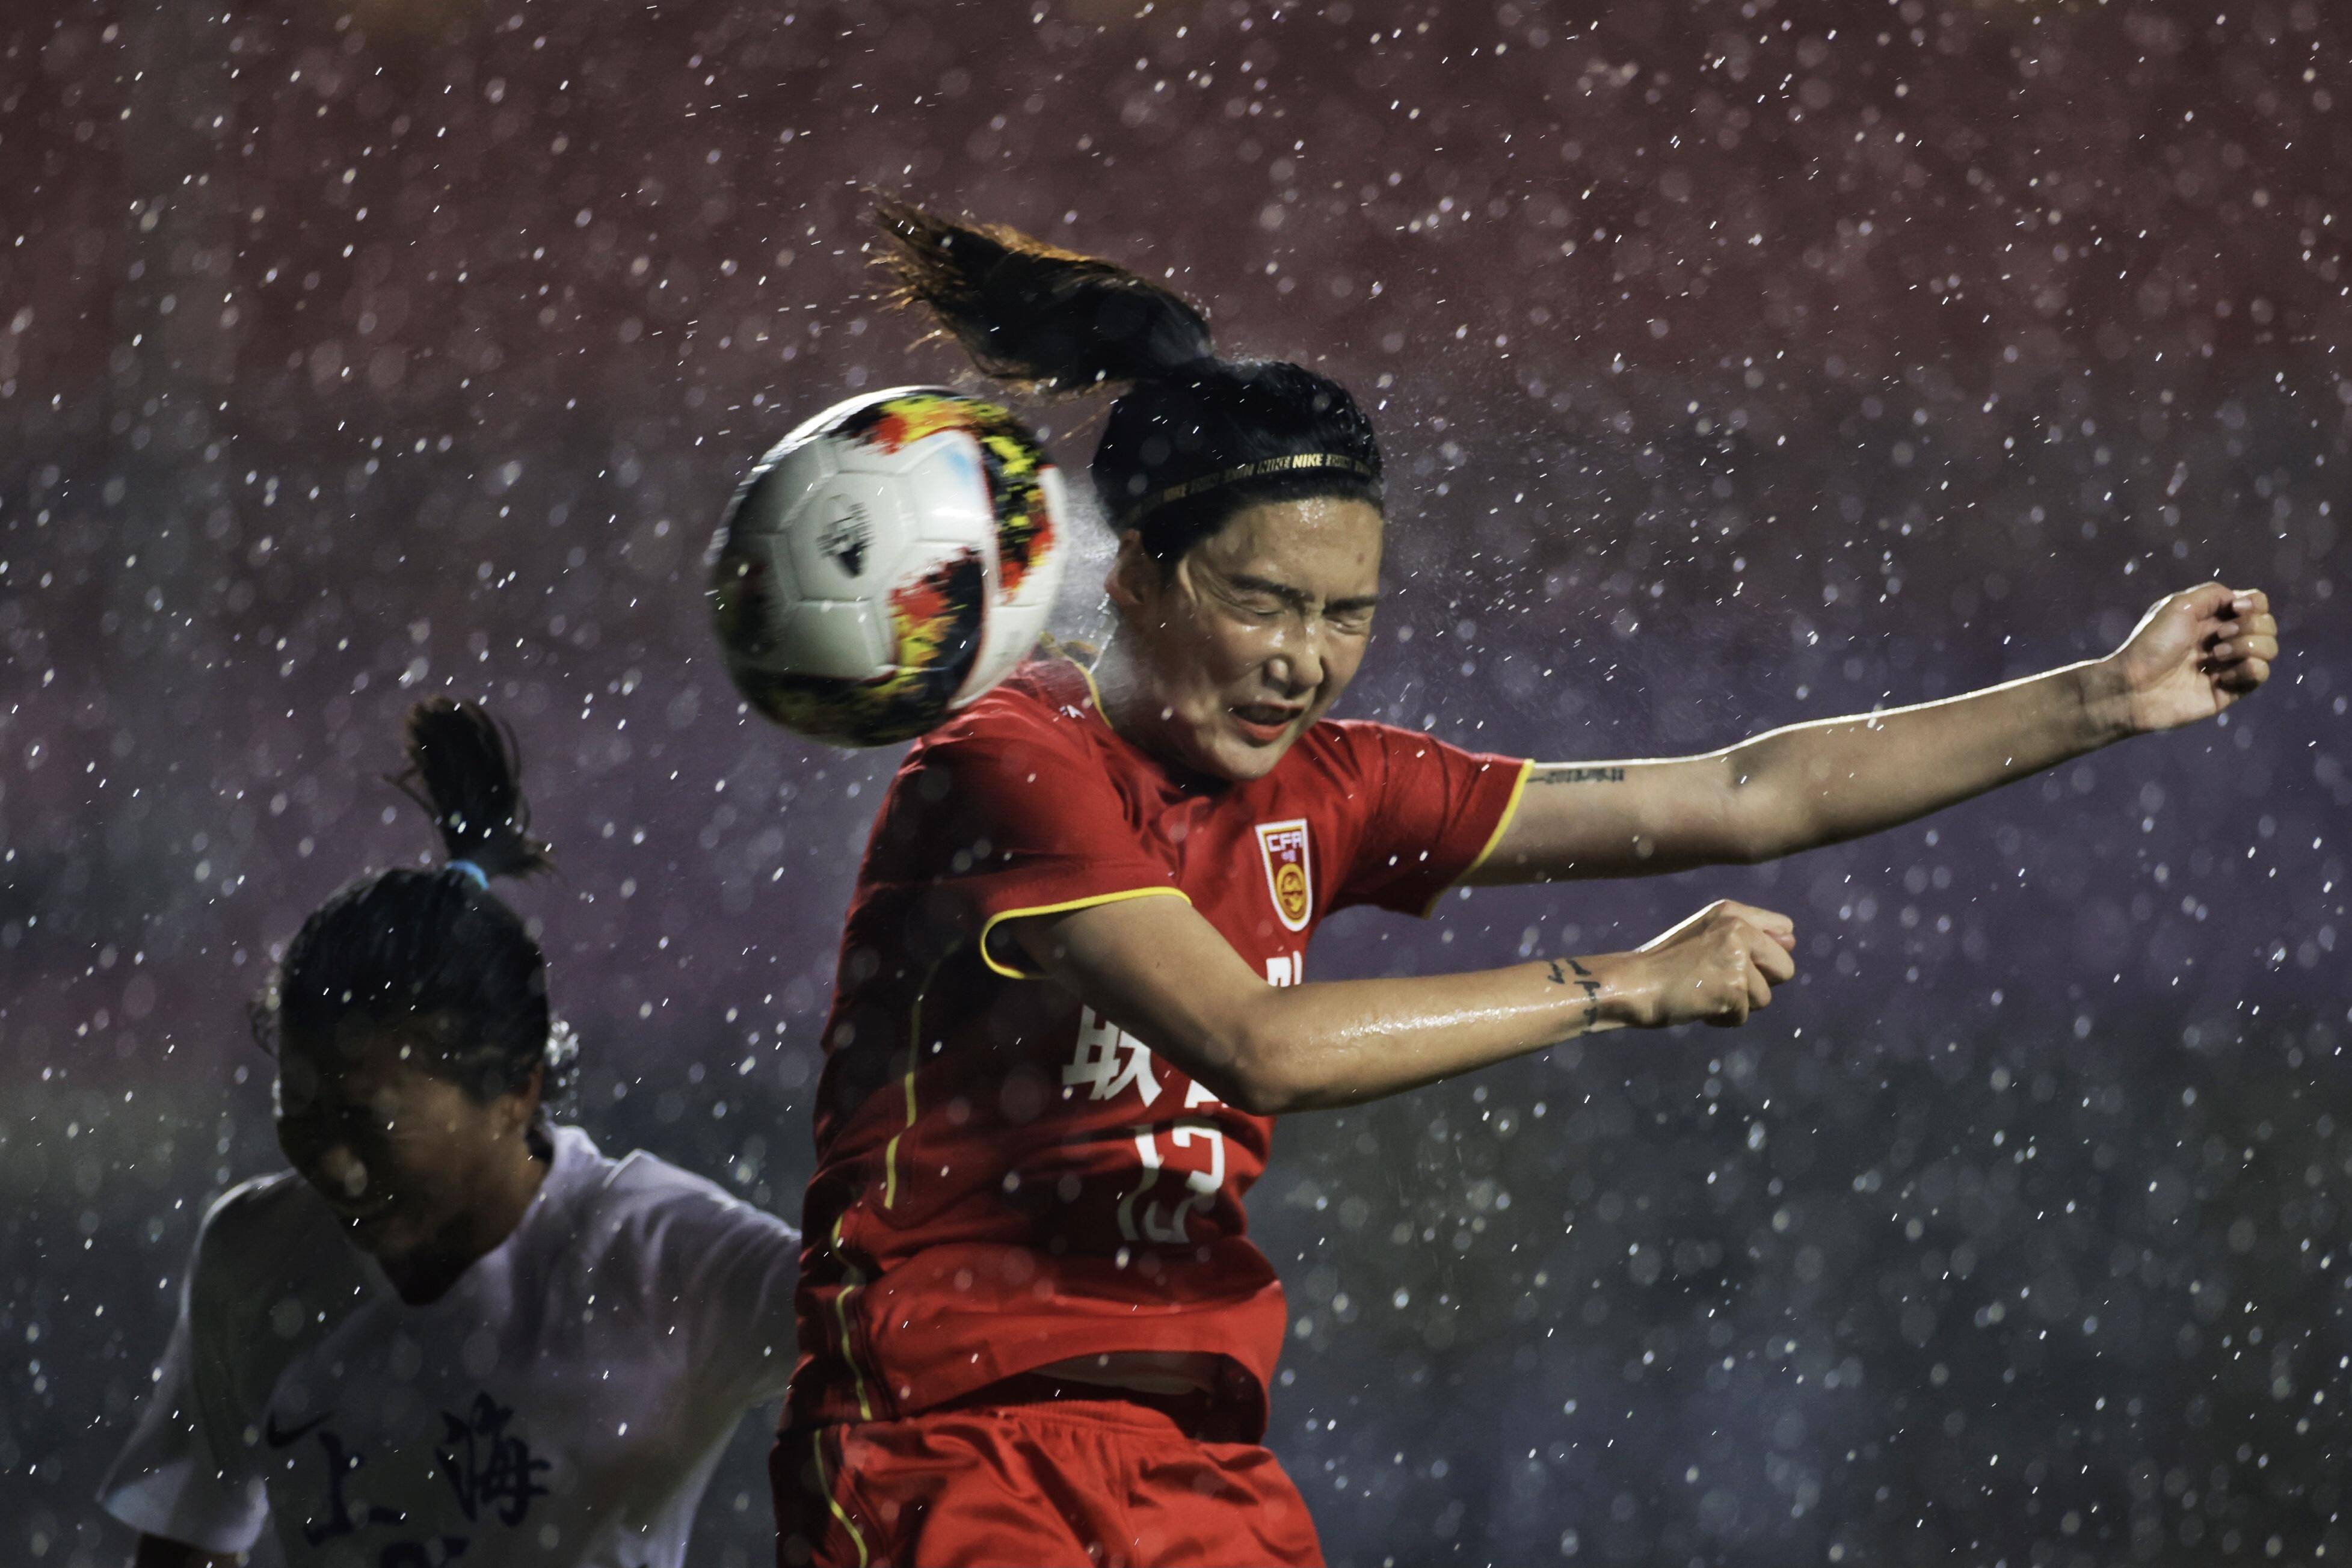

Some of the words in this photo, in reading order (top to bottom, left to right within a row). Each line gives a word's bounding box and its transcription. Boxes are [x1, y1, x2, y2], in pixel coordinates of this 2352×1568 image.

[1292, 453, 1323, 469] NIKE
[1266, 831, 1302, 852] CFA
[304, 1392, 552, 1548] 上海
